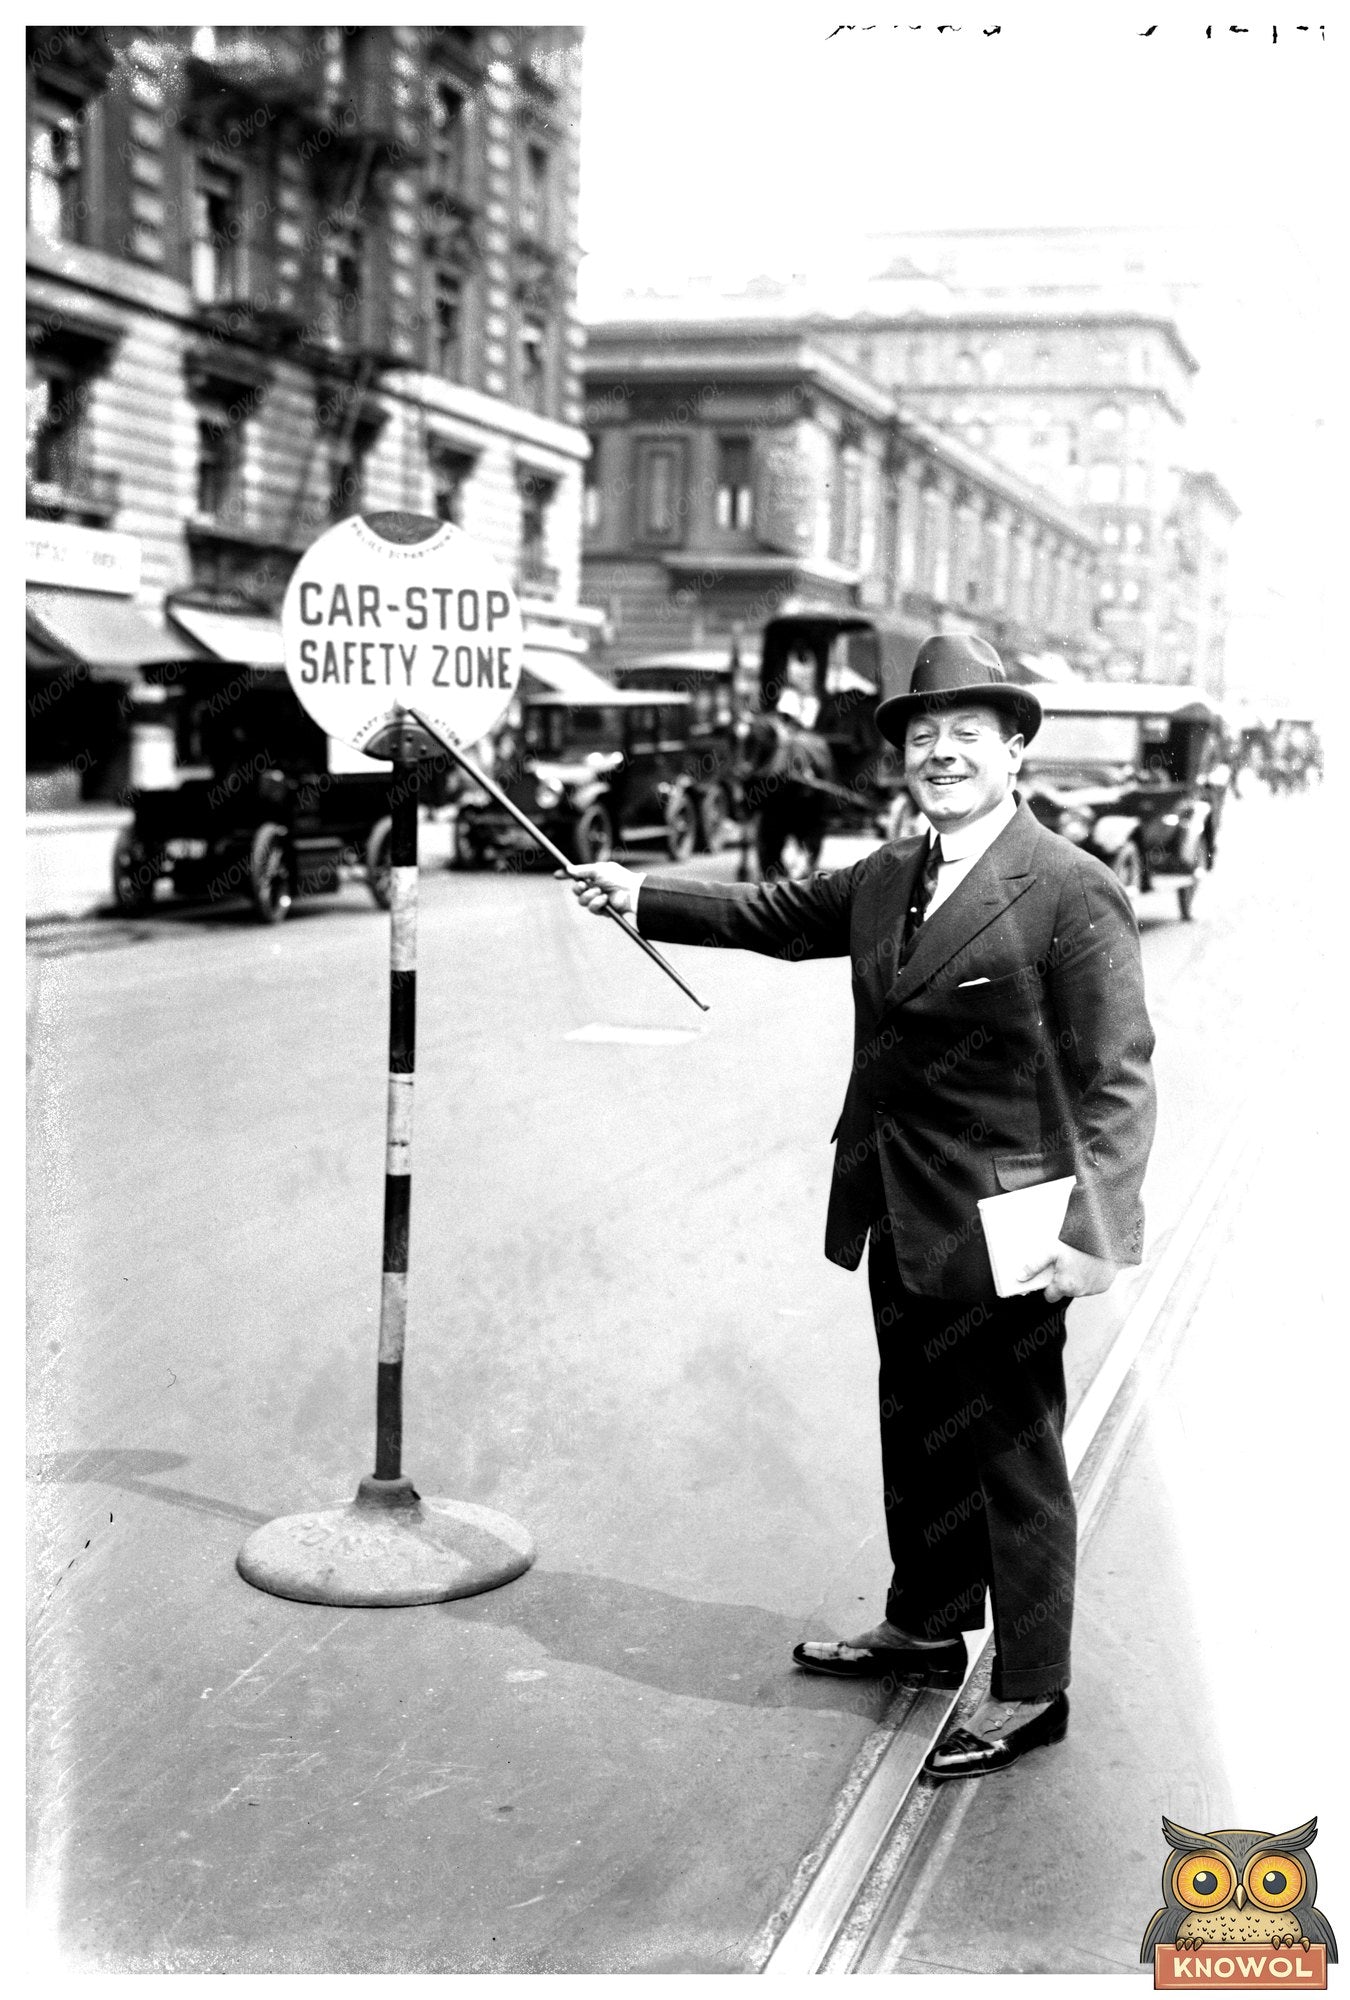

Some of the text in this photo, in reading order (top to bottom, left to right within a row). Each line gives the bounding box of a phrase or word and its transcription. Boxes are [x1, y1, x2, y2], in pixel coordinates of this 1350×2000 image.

[300, 581, 510, 632] CAR-STOP
[300, 639, 512, 689] SAFETY ZONE
